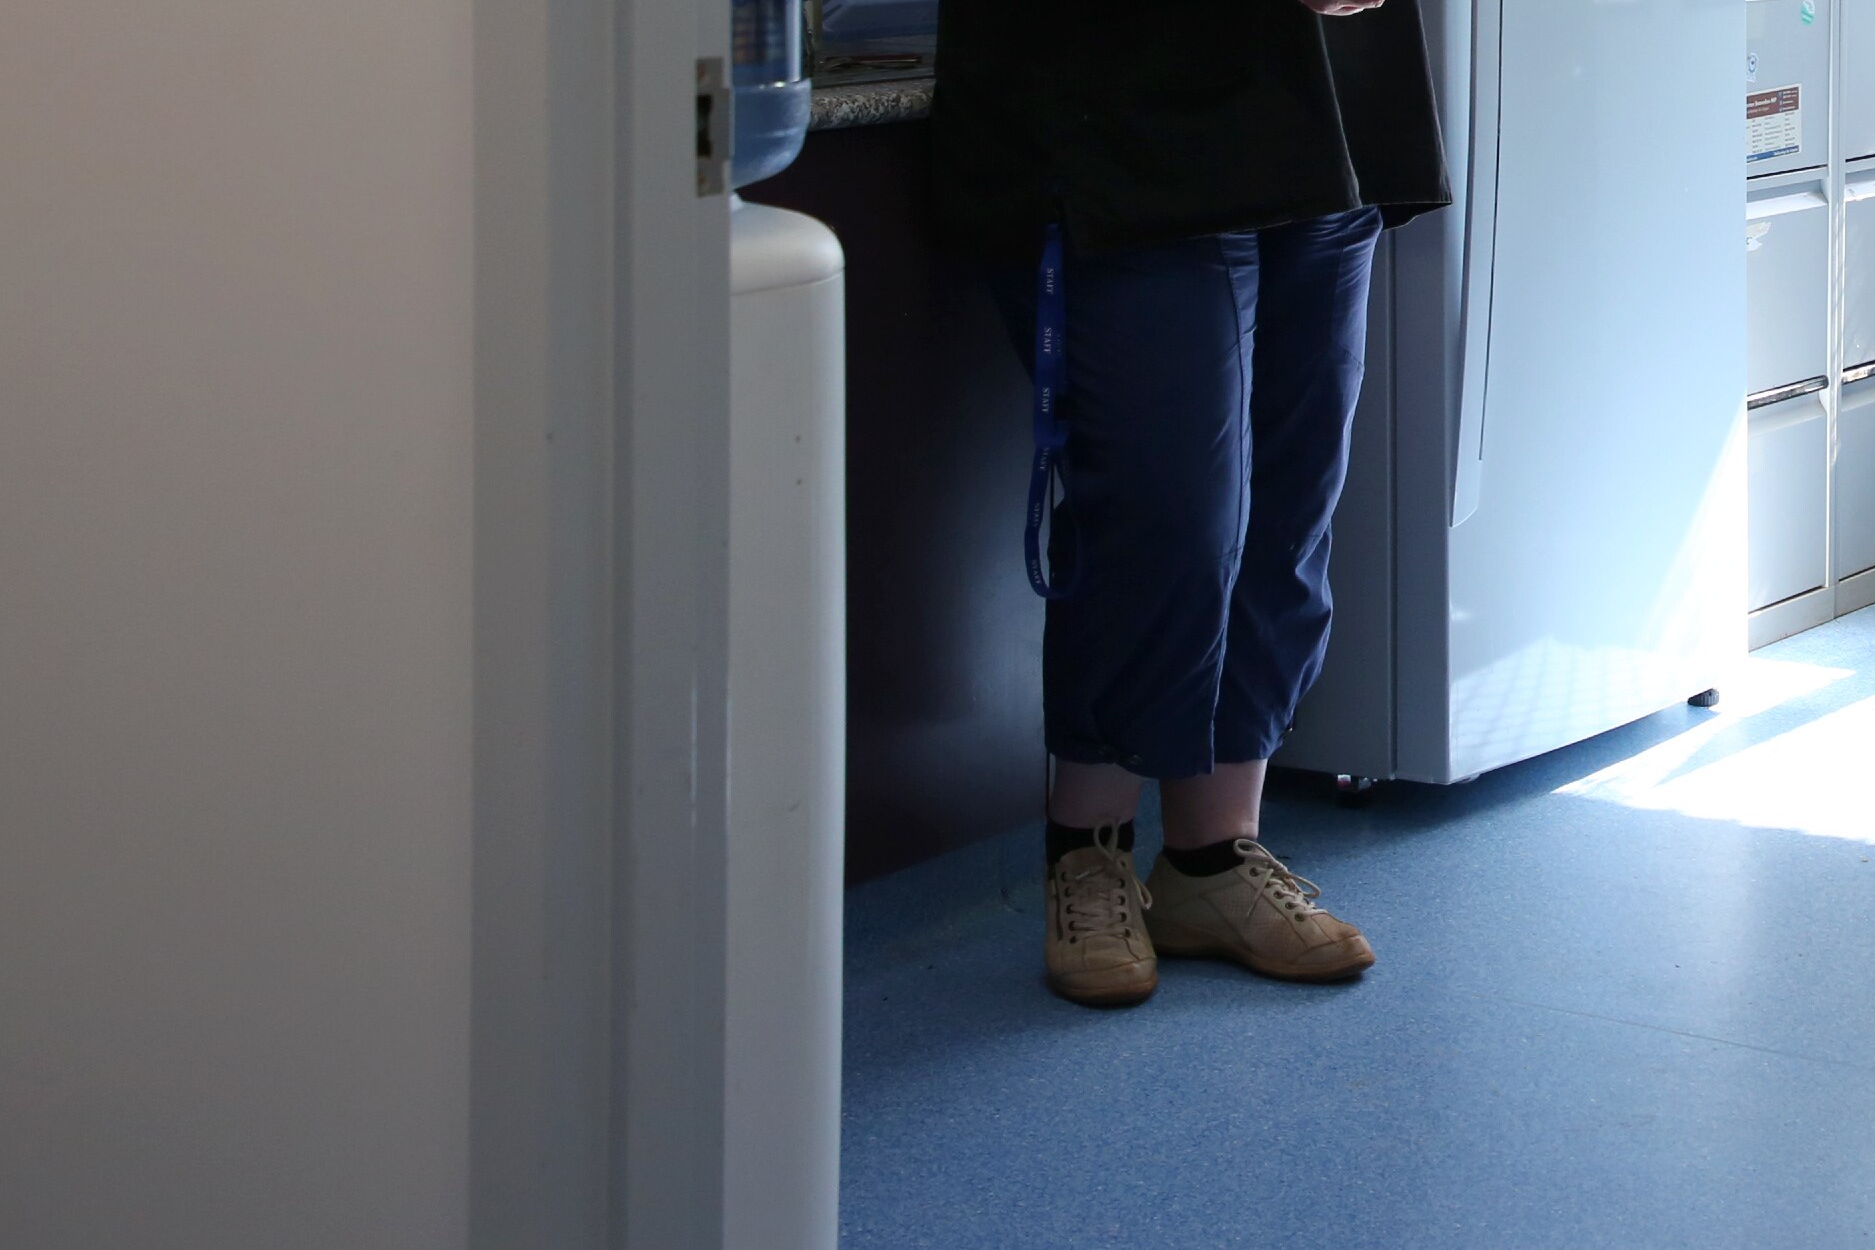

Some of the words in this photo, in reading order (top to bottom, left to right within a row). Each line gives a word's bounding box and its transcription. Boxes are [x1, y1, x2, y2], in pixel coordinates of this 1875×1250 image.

[1045, 268, 1054, 295] STAFF
[1043, 326, 1052, 355] STAFF
[1041, 387, 1050, 414] STAFF
